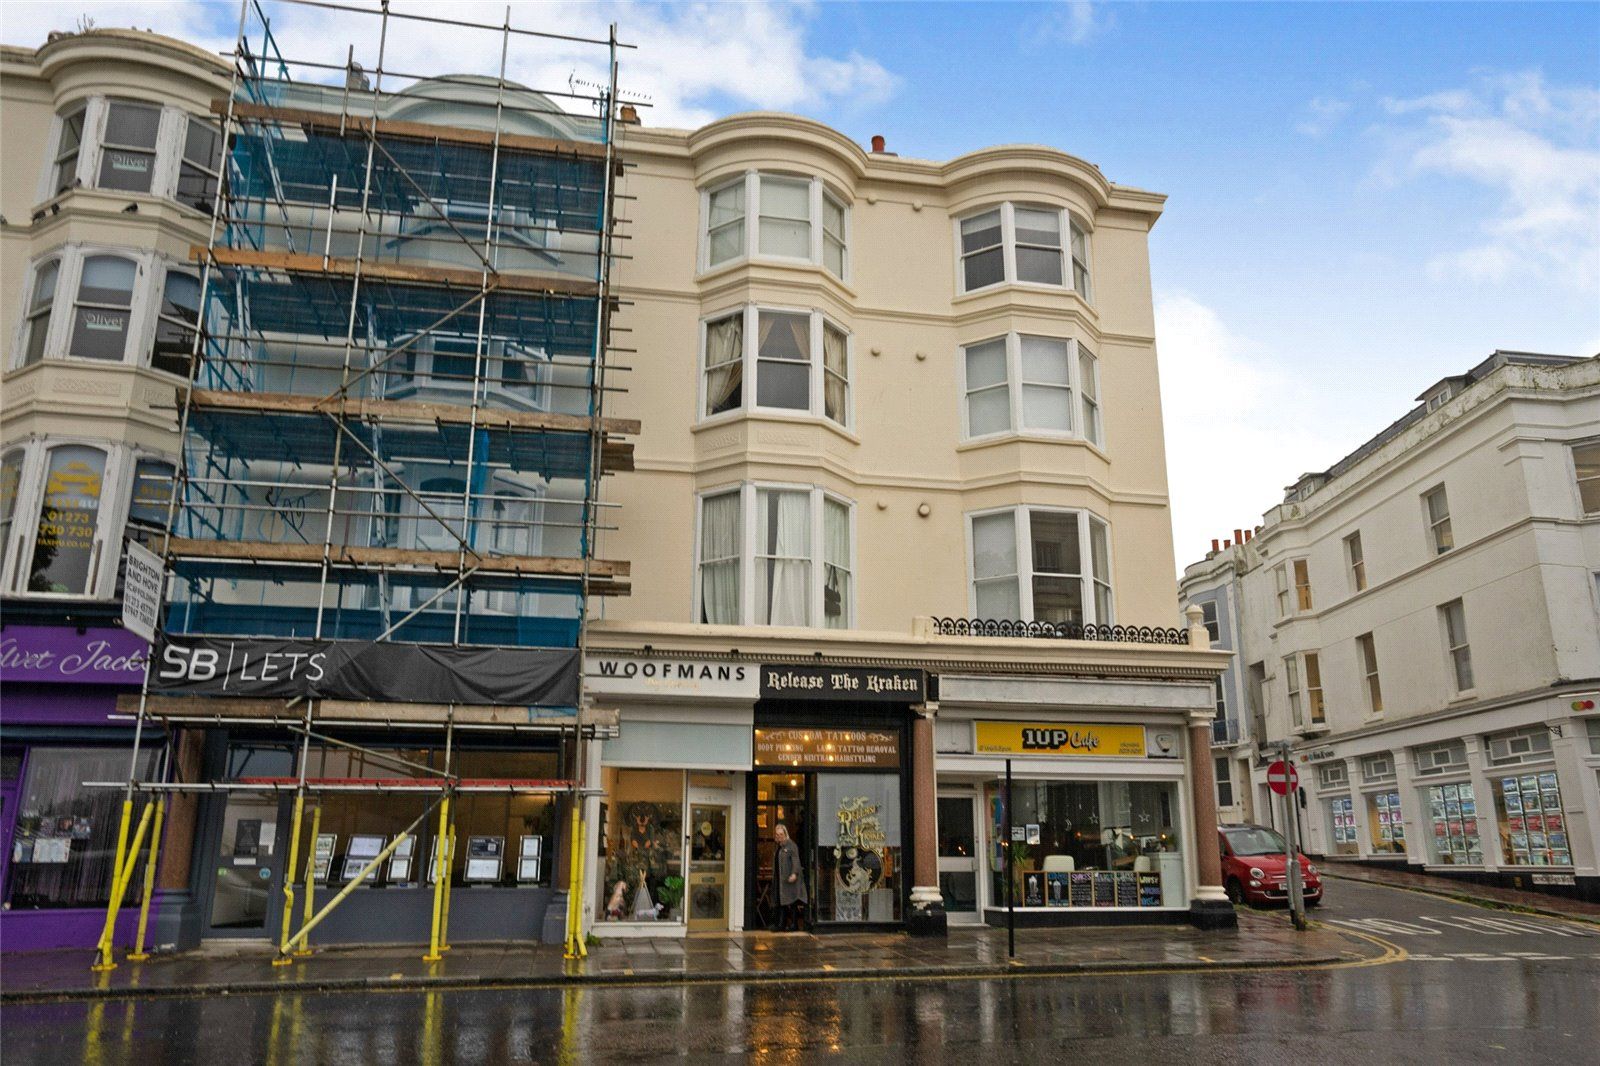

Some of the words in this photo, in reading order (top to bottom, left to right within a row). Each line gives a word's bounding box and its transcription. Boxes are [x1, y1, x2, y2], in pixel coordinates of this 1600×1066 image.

[48, 511, 89, 524] 01273
[39, 526, 65, 536] 730
[68, 528, 92, 538] 730
[128, 554, 160, 582] BRIGHTON
[127, 568, 142, 584] AND
[142, 577, 158, 594] HOVE
[159, 644, 219, 681] SB
[240, 652, 327, 682] LETS
[599, 661, 745, 681] WOOFMANS
[767, 672, 824, 690] Release
[830, 673, 859, 691] The
[866, 674, 918, 693] Kraken
[1023, 729, 1068, 749] 1UP
[803, 754, 833, 763] NEUTRA
